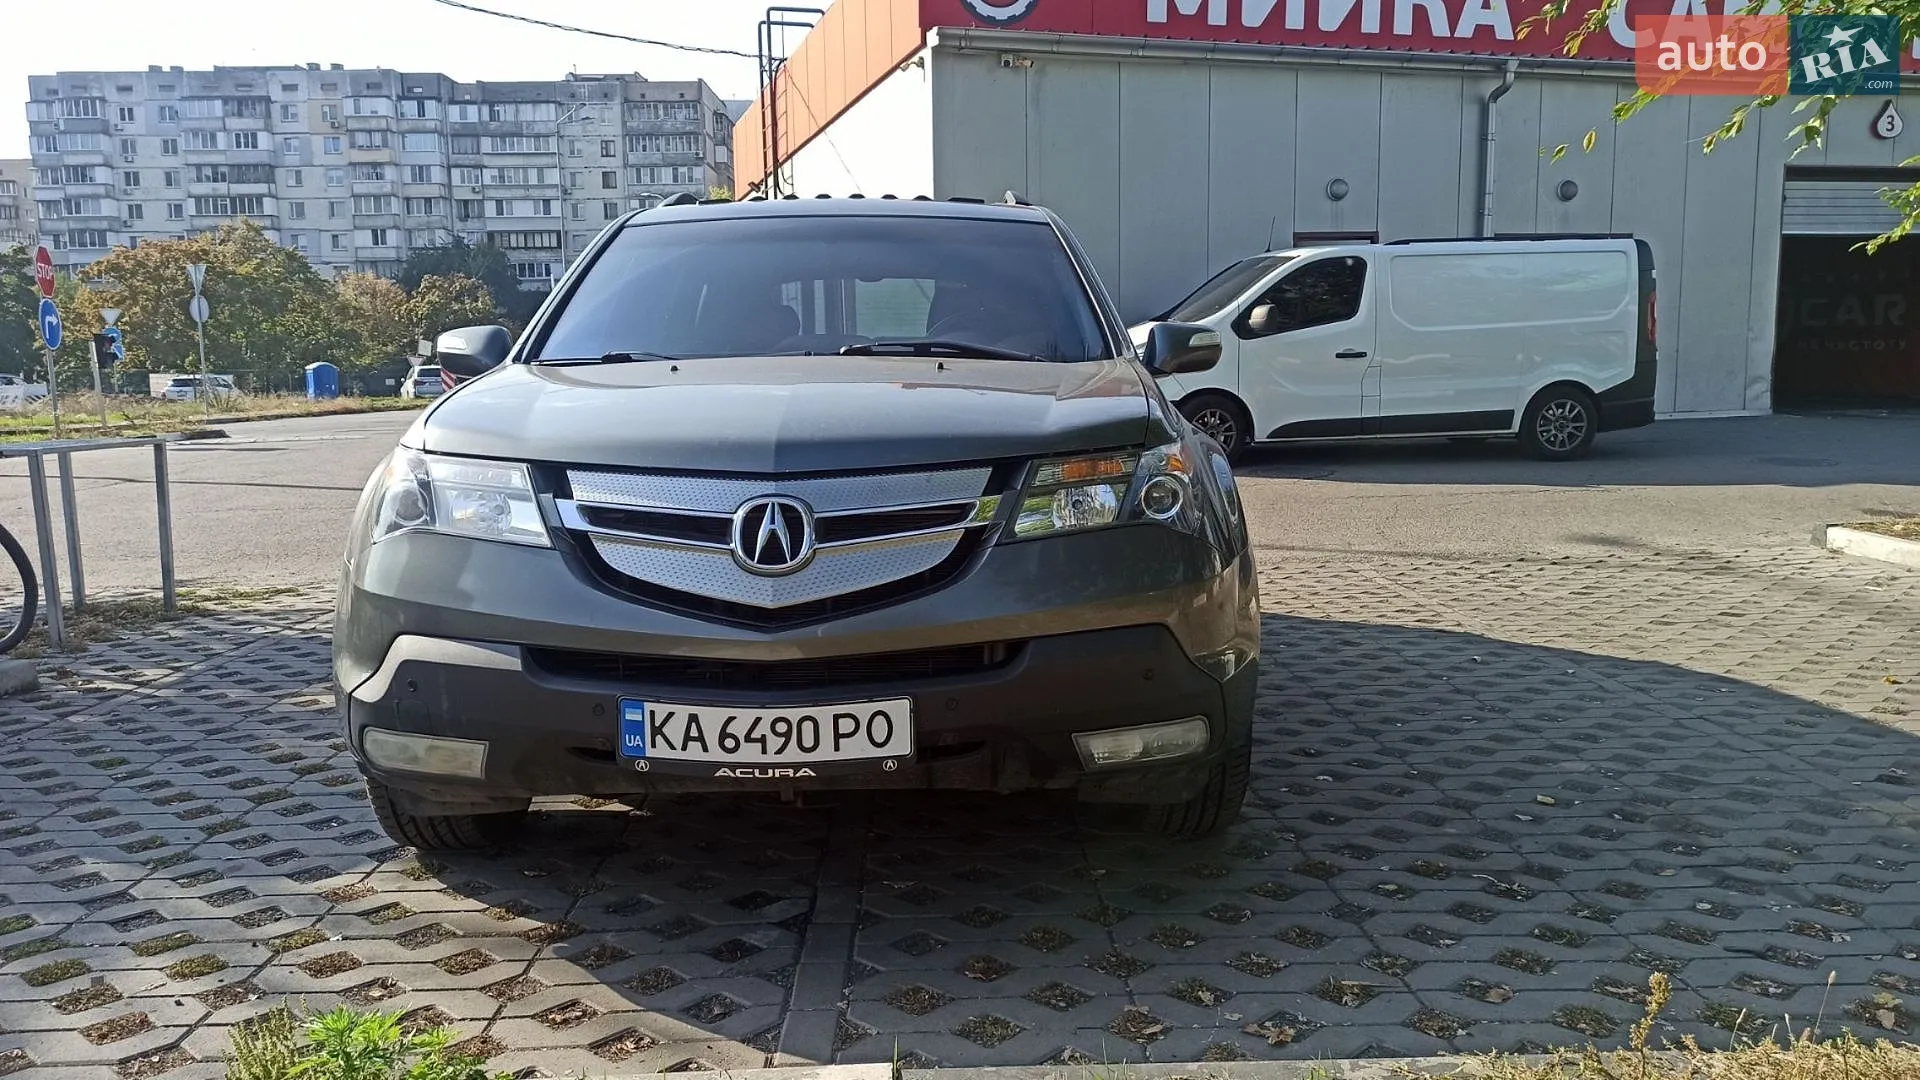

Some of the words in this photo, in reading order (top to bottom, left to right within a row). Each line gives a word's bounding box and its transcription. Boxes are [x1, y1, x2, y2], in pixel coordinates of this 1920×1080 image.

[1886, 115, 1895, 132] 3
[37, 262, 53, 280] STOP
[626, 734, 643, 748] UA
[714, 767, 817, 778] ACURA
